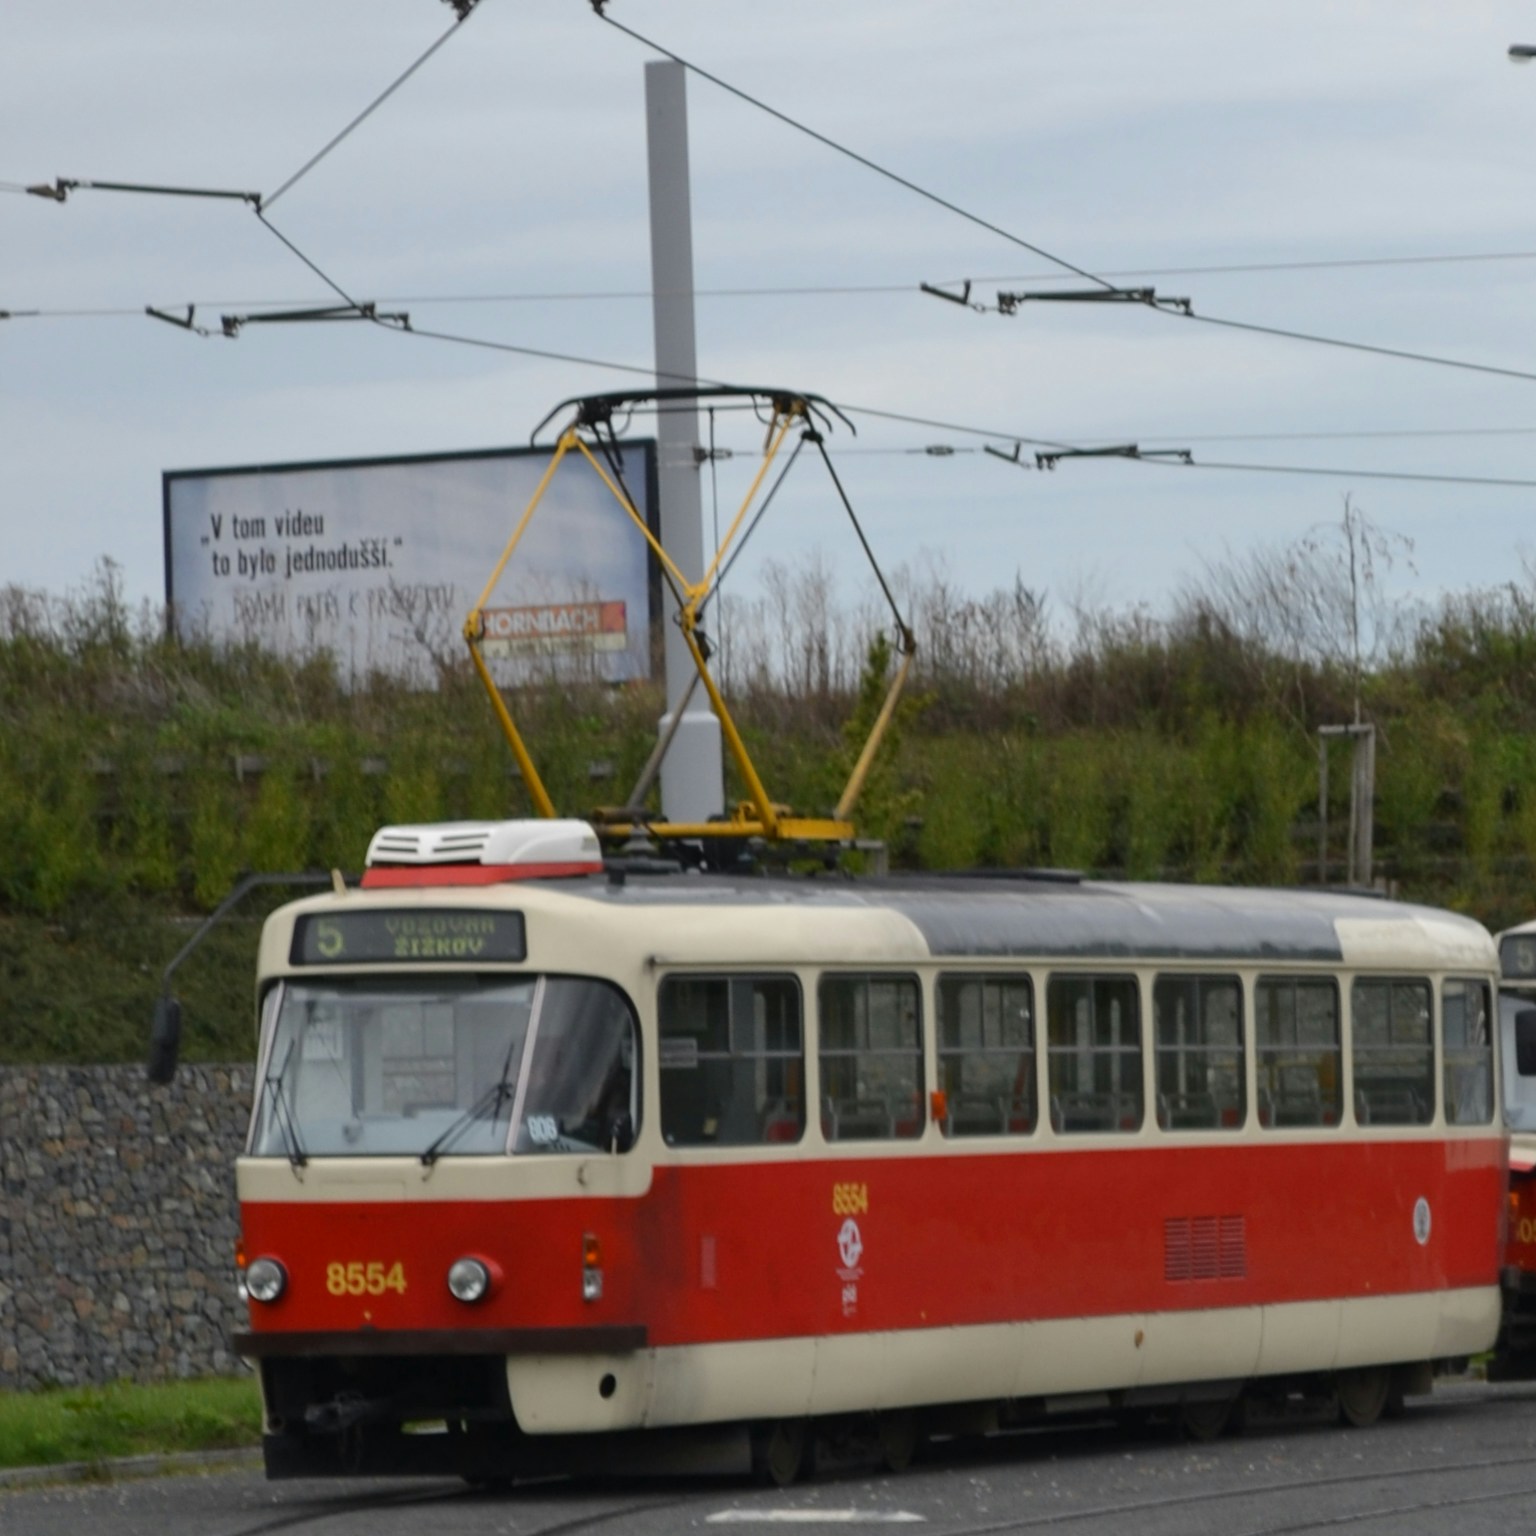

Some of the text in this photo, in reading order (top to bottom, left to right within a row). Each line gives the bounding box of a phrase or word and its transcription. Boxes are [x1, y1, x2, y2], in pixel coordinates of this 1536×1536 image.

[232, 513, 266, 540] tom
[274, 509, 324, 538] videu
[212, 550, 231, 577] to
[238, 547, 276, 580] bylo
[316, 916, 345, 958] 5
[1517, 942, 1534, 973] 5
[832, 1182, 869, 1216] 8554
[326, 1261, 408, 1296] 8554
